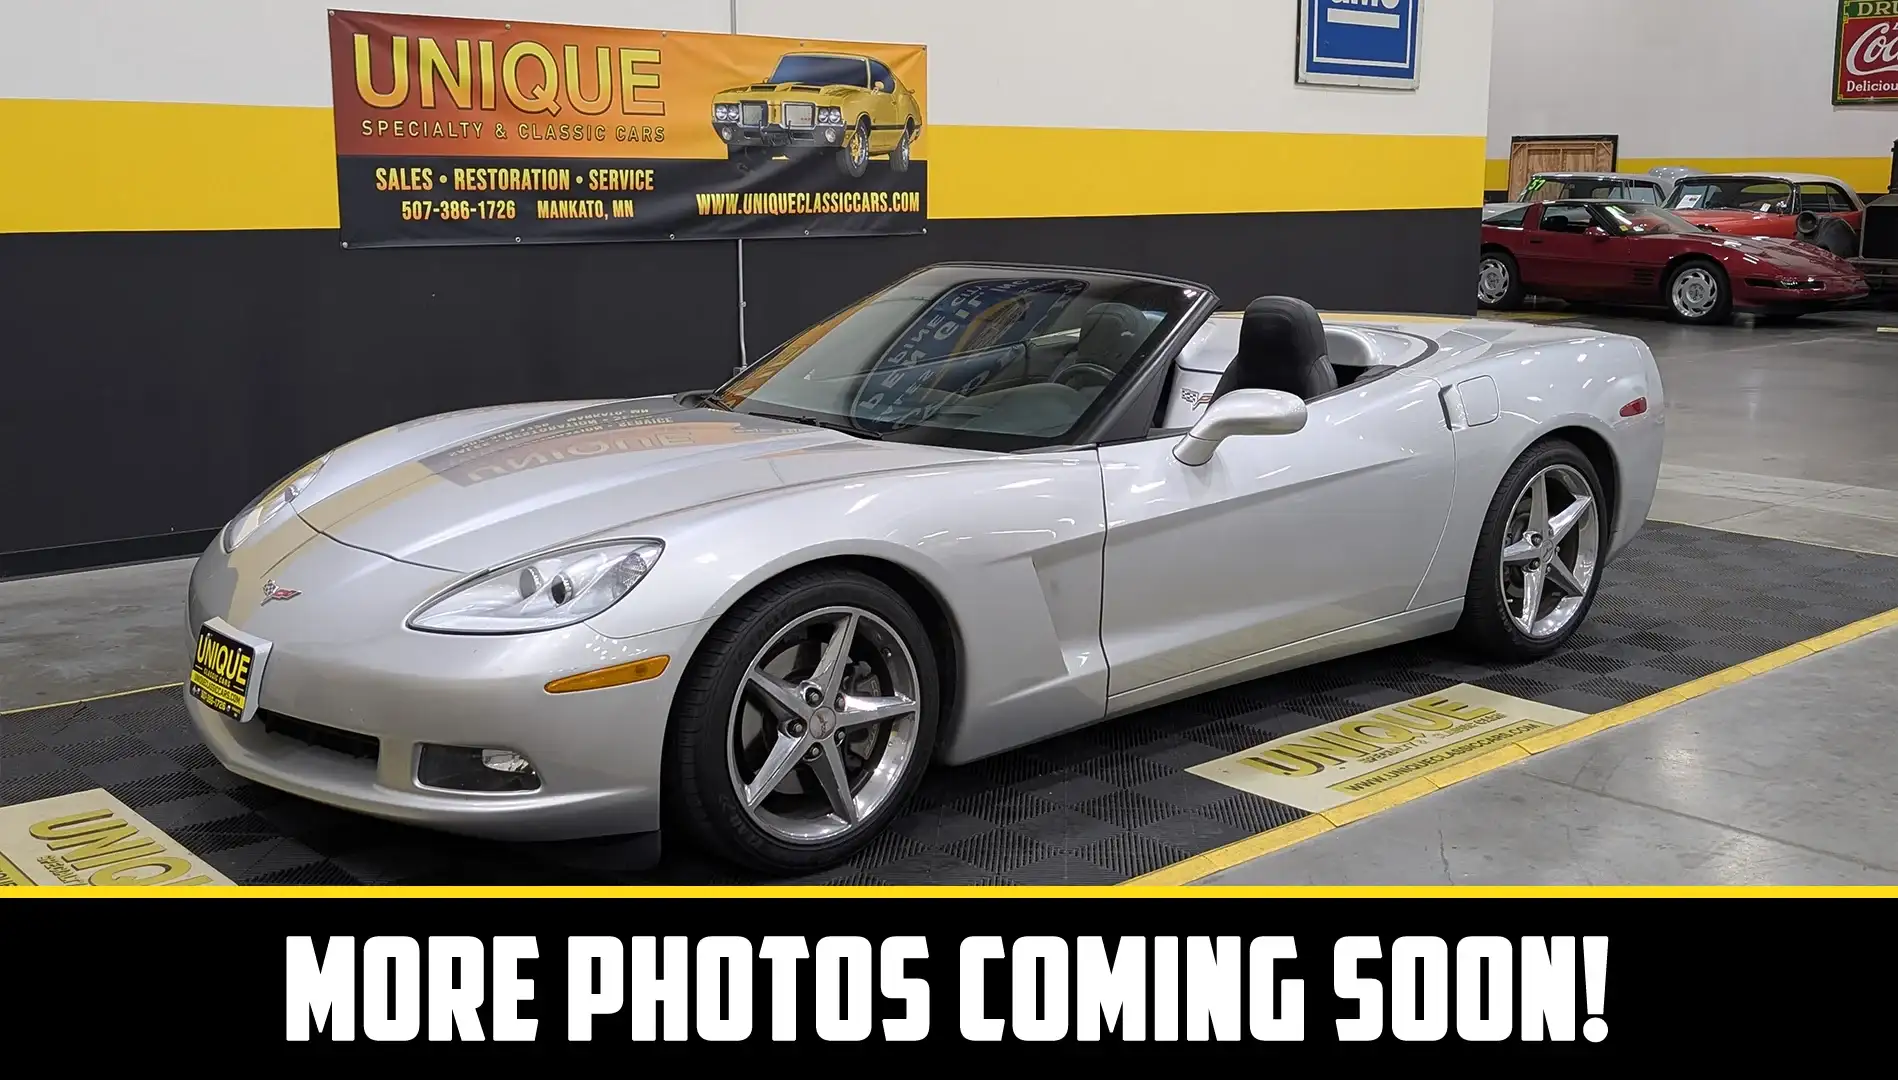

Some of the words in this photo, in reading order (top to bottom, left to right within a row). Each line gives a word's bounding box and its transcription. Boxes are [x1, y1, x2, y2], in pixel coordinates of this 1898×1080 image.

[353, 32, 666, 117] UNIQUE
[361, 119, 484, 140] SPECIALTY
[494, 123, 507, 139] &
[518, 123, 606, 142] CLASSIC
[616, 125, 666, 143] CARS
[375, 167, 433, 191] SALES
[454, 168, 570, 191] RESTORATION
[588, 168, 655, 191] SERVICE
[401, 199, 516, 220] 507-386-1726
[537, 200, 609, 220] MANKATO,
[612, 199, 634, 218] MN
[696, 191, 920, 216] WWW.UNIQUECLASSICCARS.COM
[196, 634, 251, 686] UNIQUE
[1237, 696, 1497, 778] UNIQUE
[28, 808, 213, 886] UNIQ
